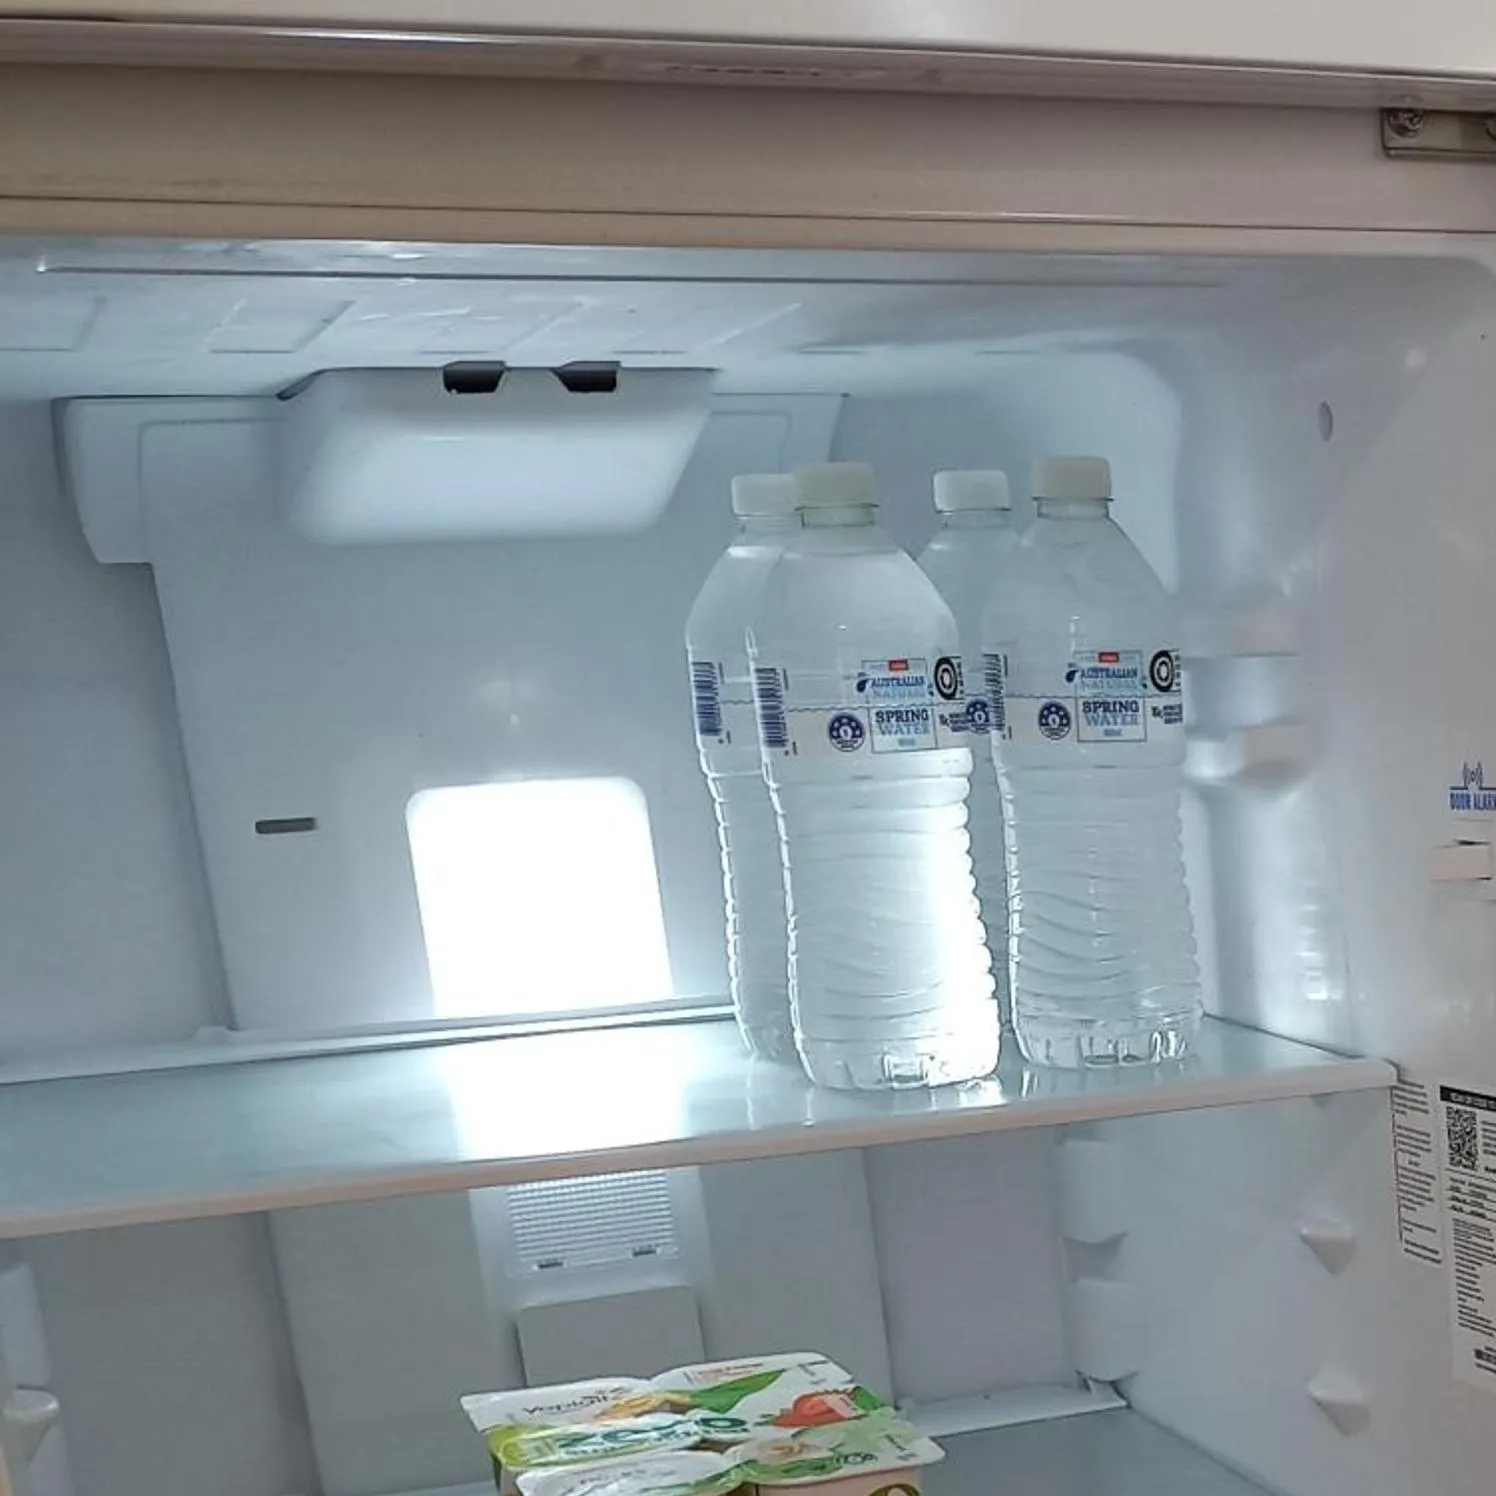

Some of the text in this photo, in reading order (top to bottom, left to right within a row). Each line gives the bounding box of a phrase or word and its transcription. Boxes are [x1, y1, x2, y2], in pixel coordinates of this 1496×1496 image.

[1082, 700, 1140, 714] SPRING
[875, 708, 929, 723] SPRING
[1085, 713, 1140, 727] WATER
[879, 720, 931, 736] WATER
